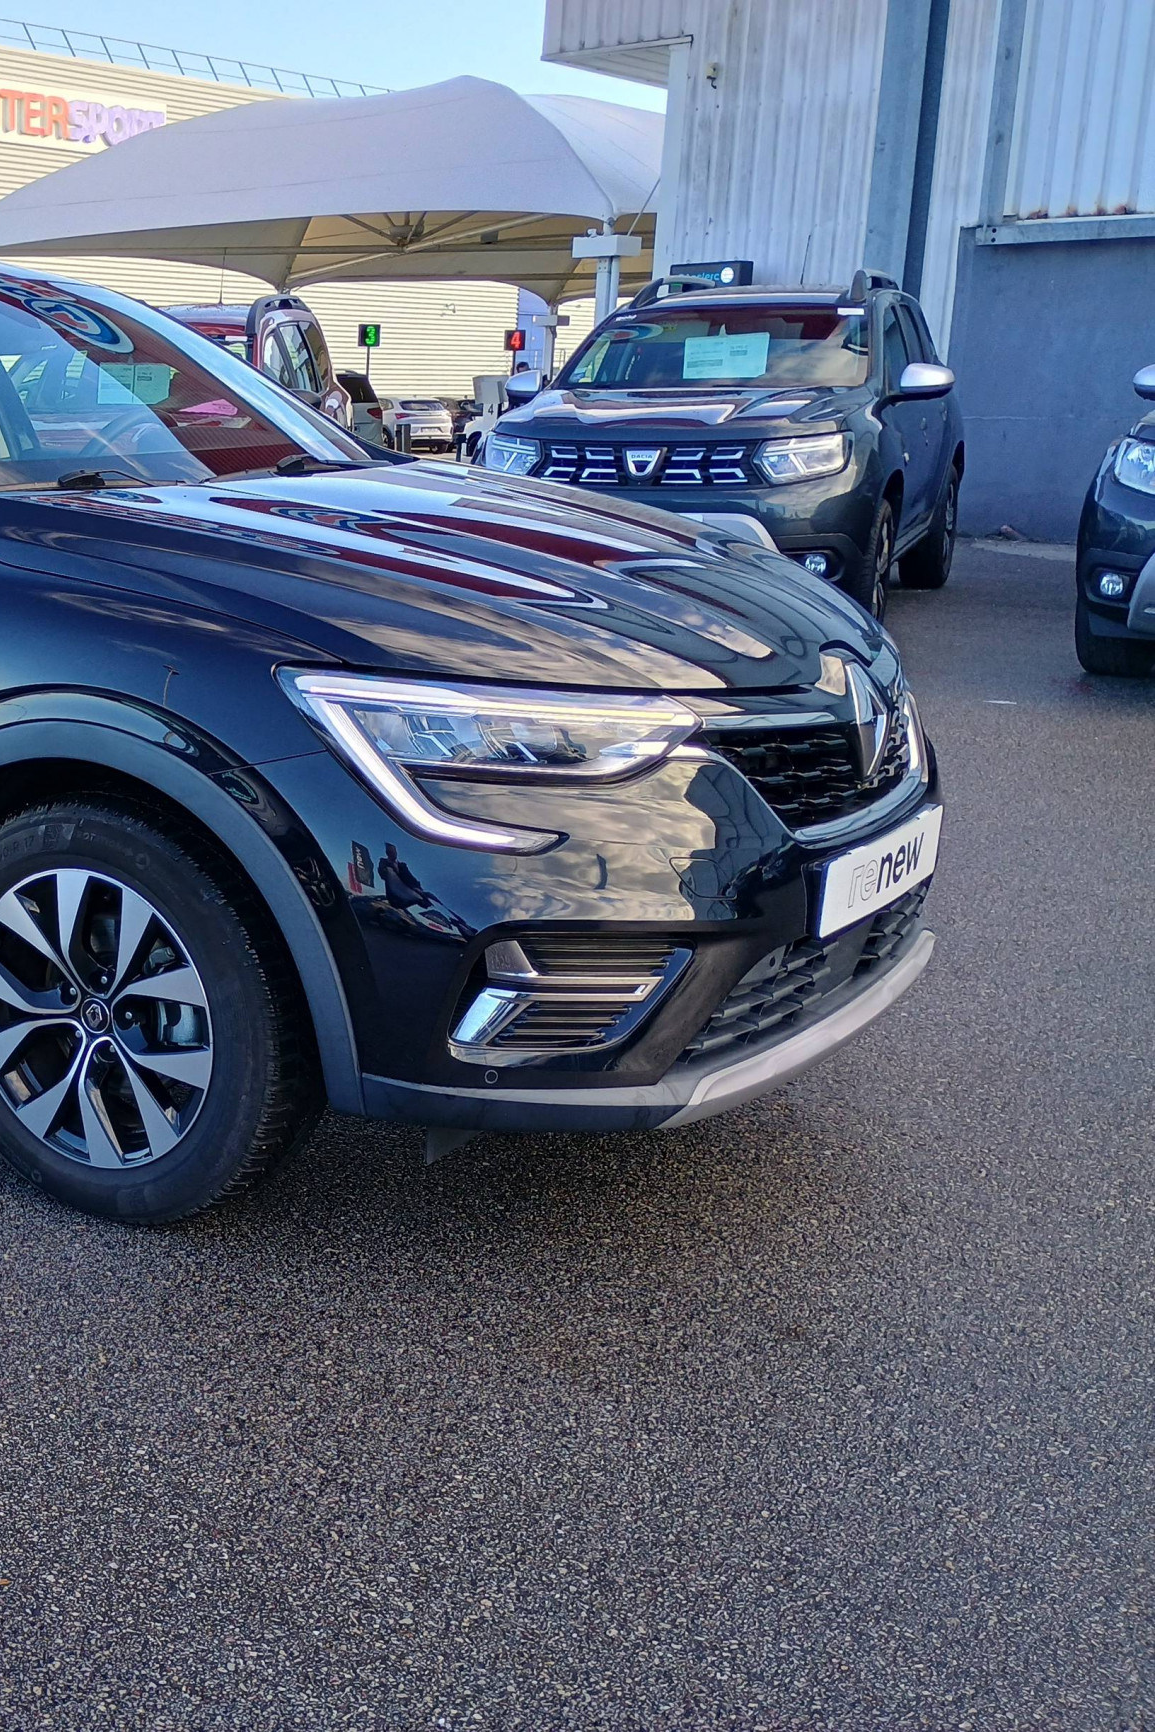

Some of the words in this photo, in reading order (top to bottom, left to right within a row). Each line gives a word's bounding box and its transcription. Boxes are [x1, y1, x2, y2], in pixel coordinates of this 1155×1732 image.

[365, 326, 376, 345] 3
[510, 331, 521, 349] 4
[487, 403, 495, 416] 4
[847, 831, 925, 909] renew
